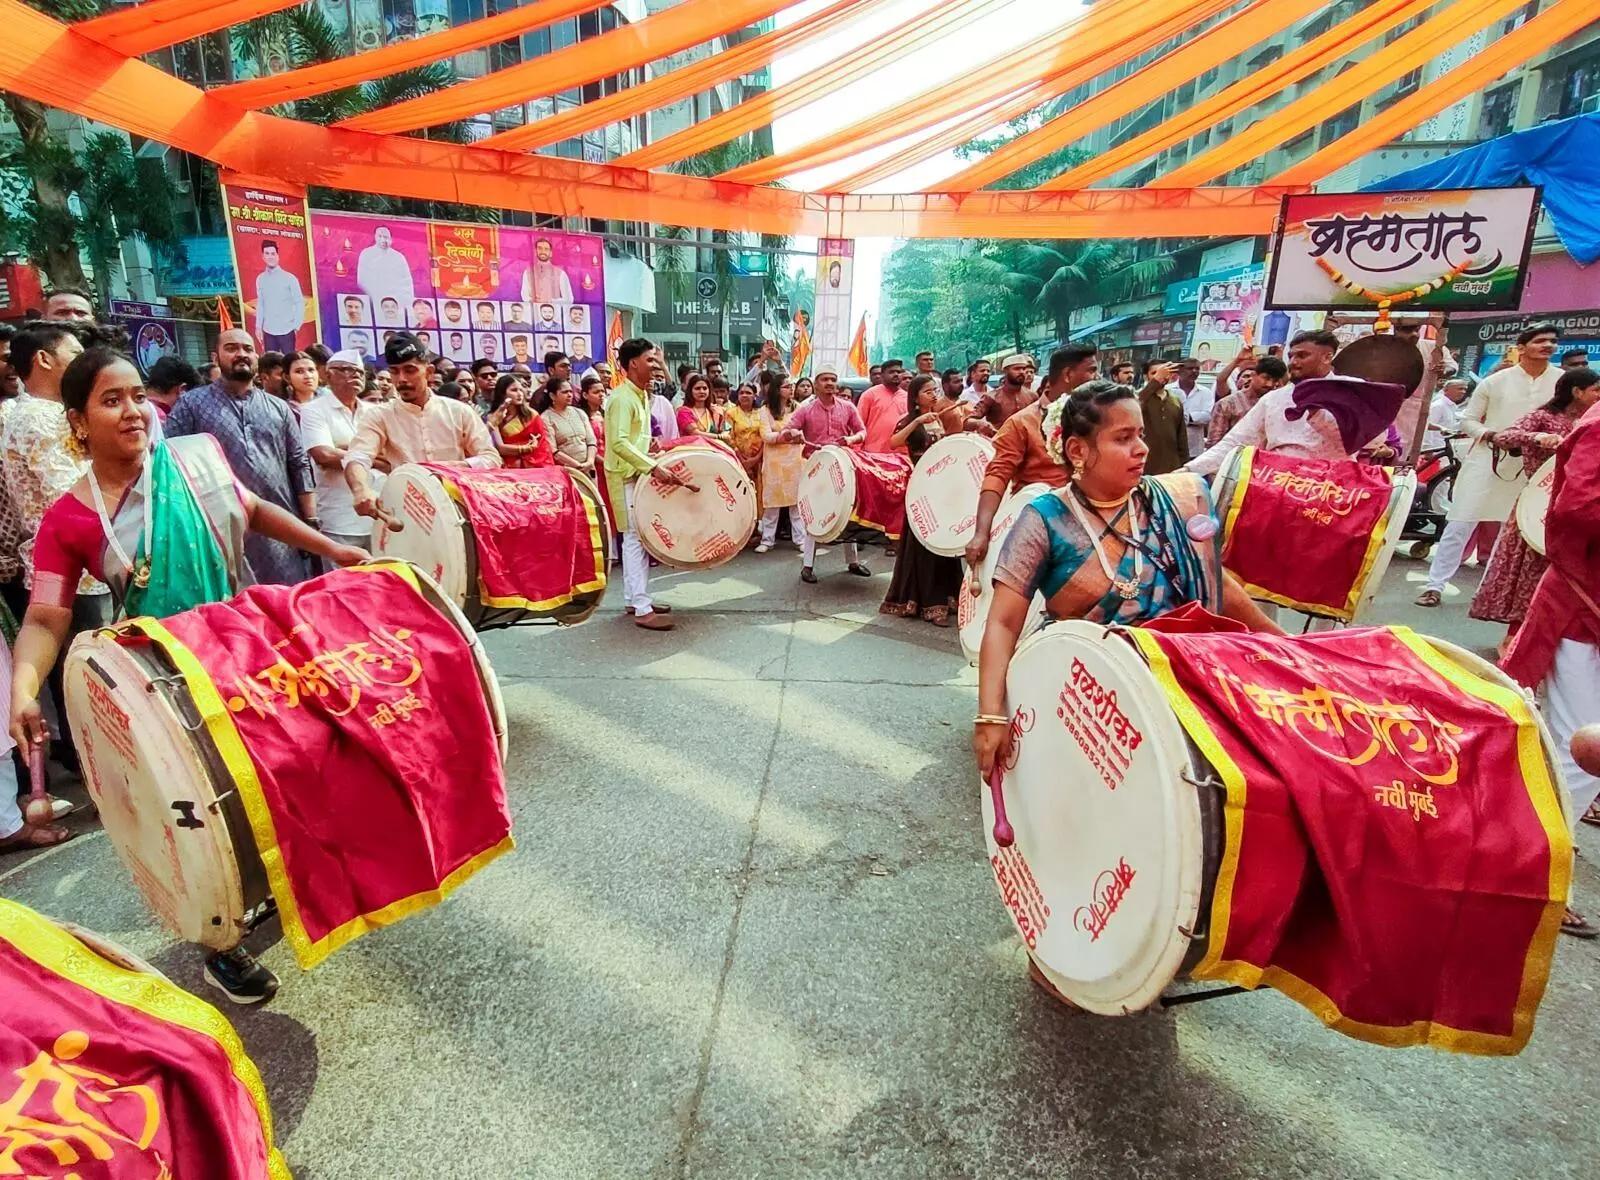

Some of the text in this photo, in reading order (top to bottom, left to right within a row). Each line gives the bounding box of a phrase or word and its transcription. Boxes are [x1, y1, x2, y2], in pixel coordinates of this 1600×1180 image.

[1306, 211, 1502, 275] ब्रह्मताल
[674, 302, 700, 314] THE
[1452, 281, 1490, 294] नवी मुंबई
[367, 688, 423, 729] नवी मुंबई
[1071, 656, 1143, 760] पळशीकर
[1243, 682, 1459, 785] ब्रह्मताल
[1064, 716, 1117, 790] 9860852129
[1374, 780, 1439, 822] नवी मुंबई
